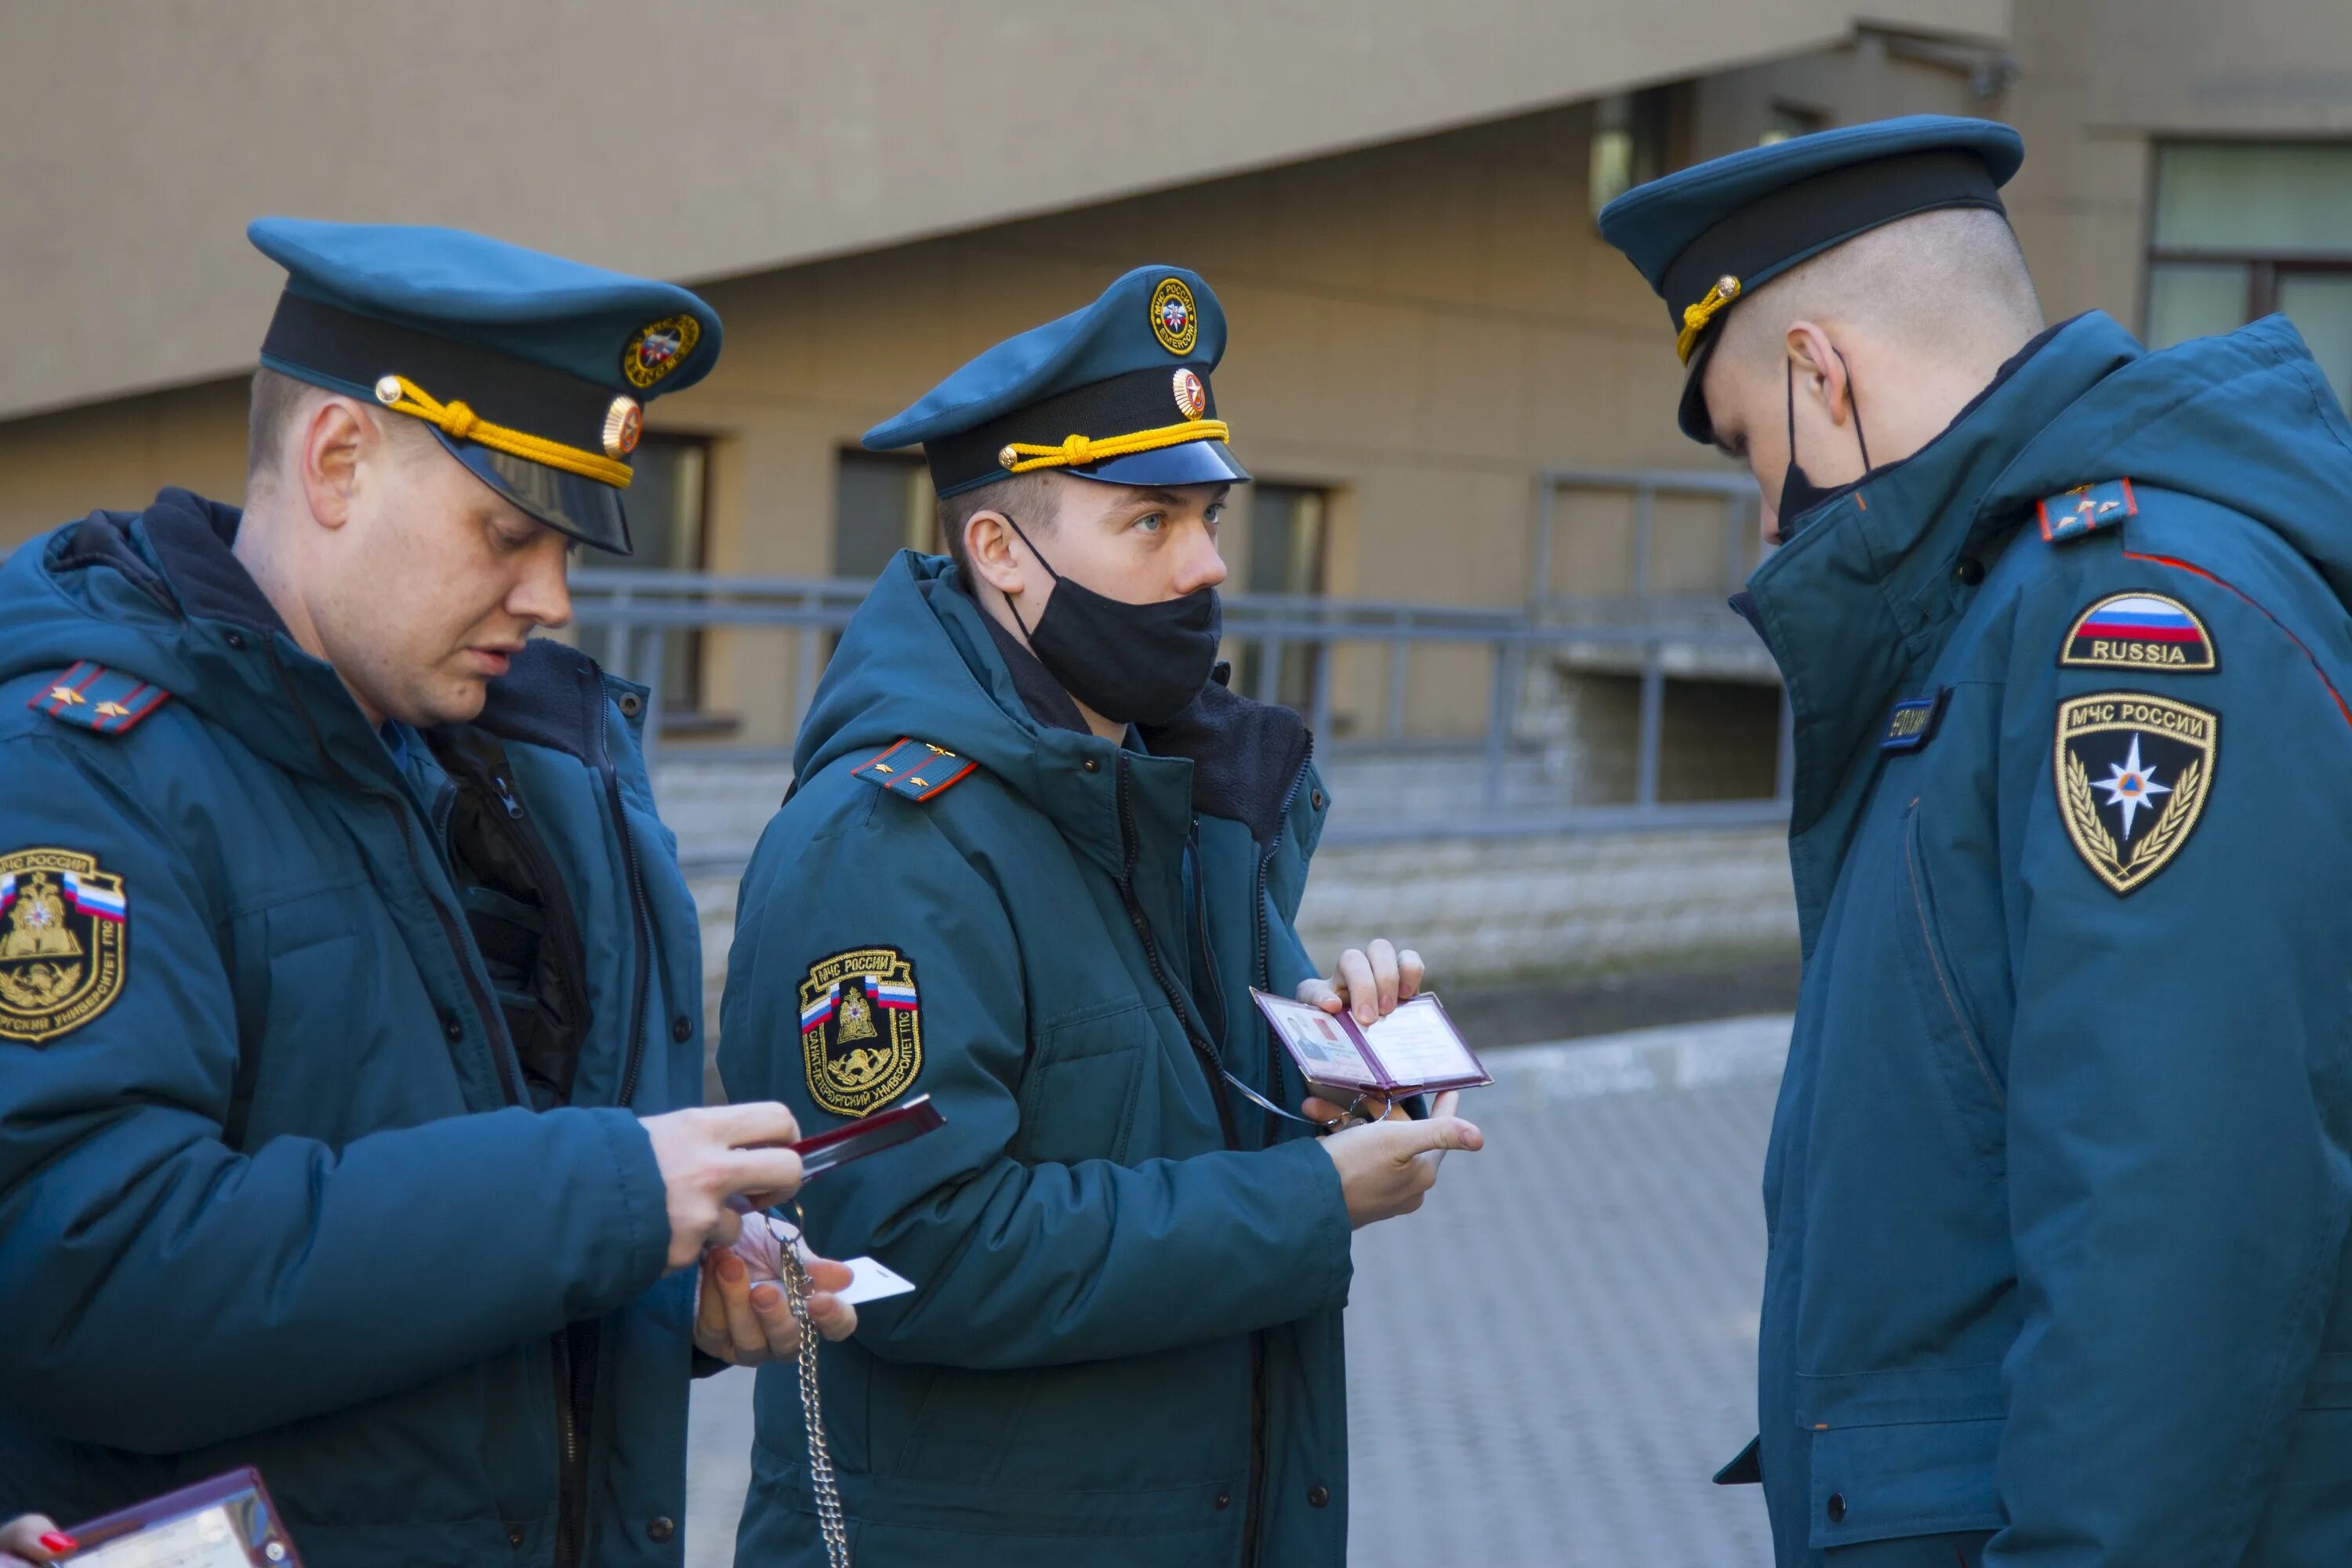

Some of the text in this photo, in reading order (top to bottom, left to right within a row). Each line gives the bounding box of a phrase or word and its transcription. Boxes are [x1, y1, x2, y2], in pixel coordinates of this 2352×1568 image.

[1154, 285, 1192, 315] МЧС РОССИИ
[1160, 324, 1194, 348] EMERCOM
[2092, 641, 2186, 663] RUSSIA
[2072, 704, 2203, 737] МЧС РОССИИ
[27, 855, 87, 871] РОССИИ
[818, 956, 889, 982] МЧС РОССИИ
[53, 953, 116, 1028] УНИВЕРСИТЕТ
[808, 1030, 873, 1108] САНКТ-ПЕТЕРБУРГСКИЙ
[873, 1039, 913, 1100] УНИВЕРСИТЕТ
